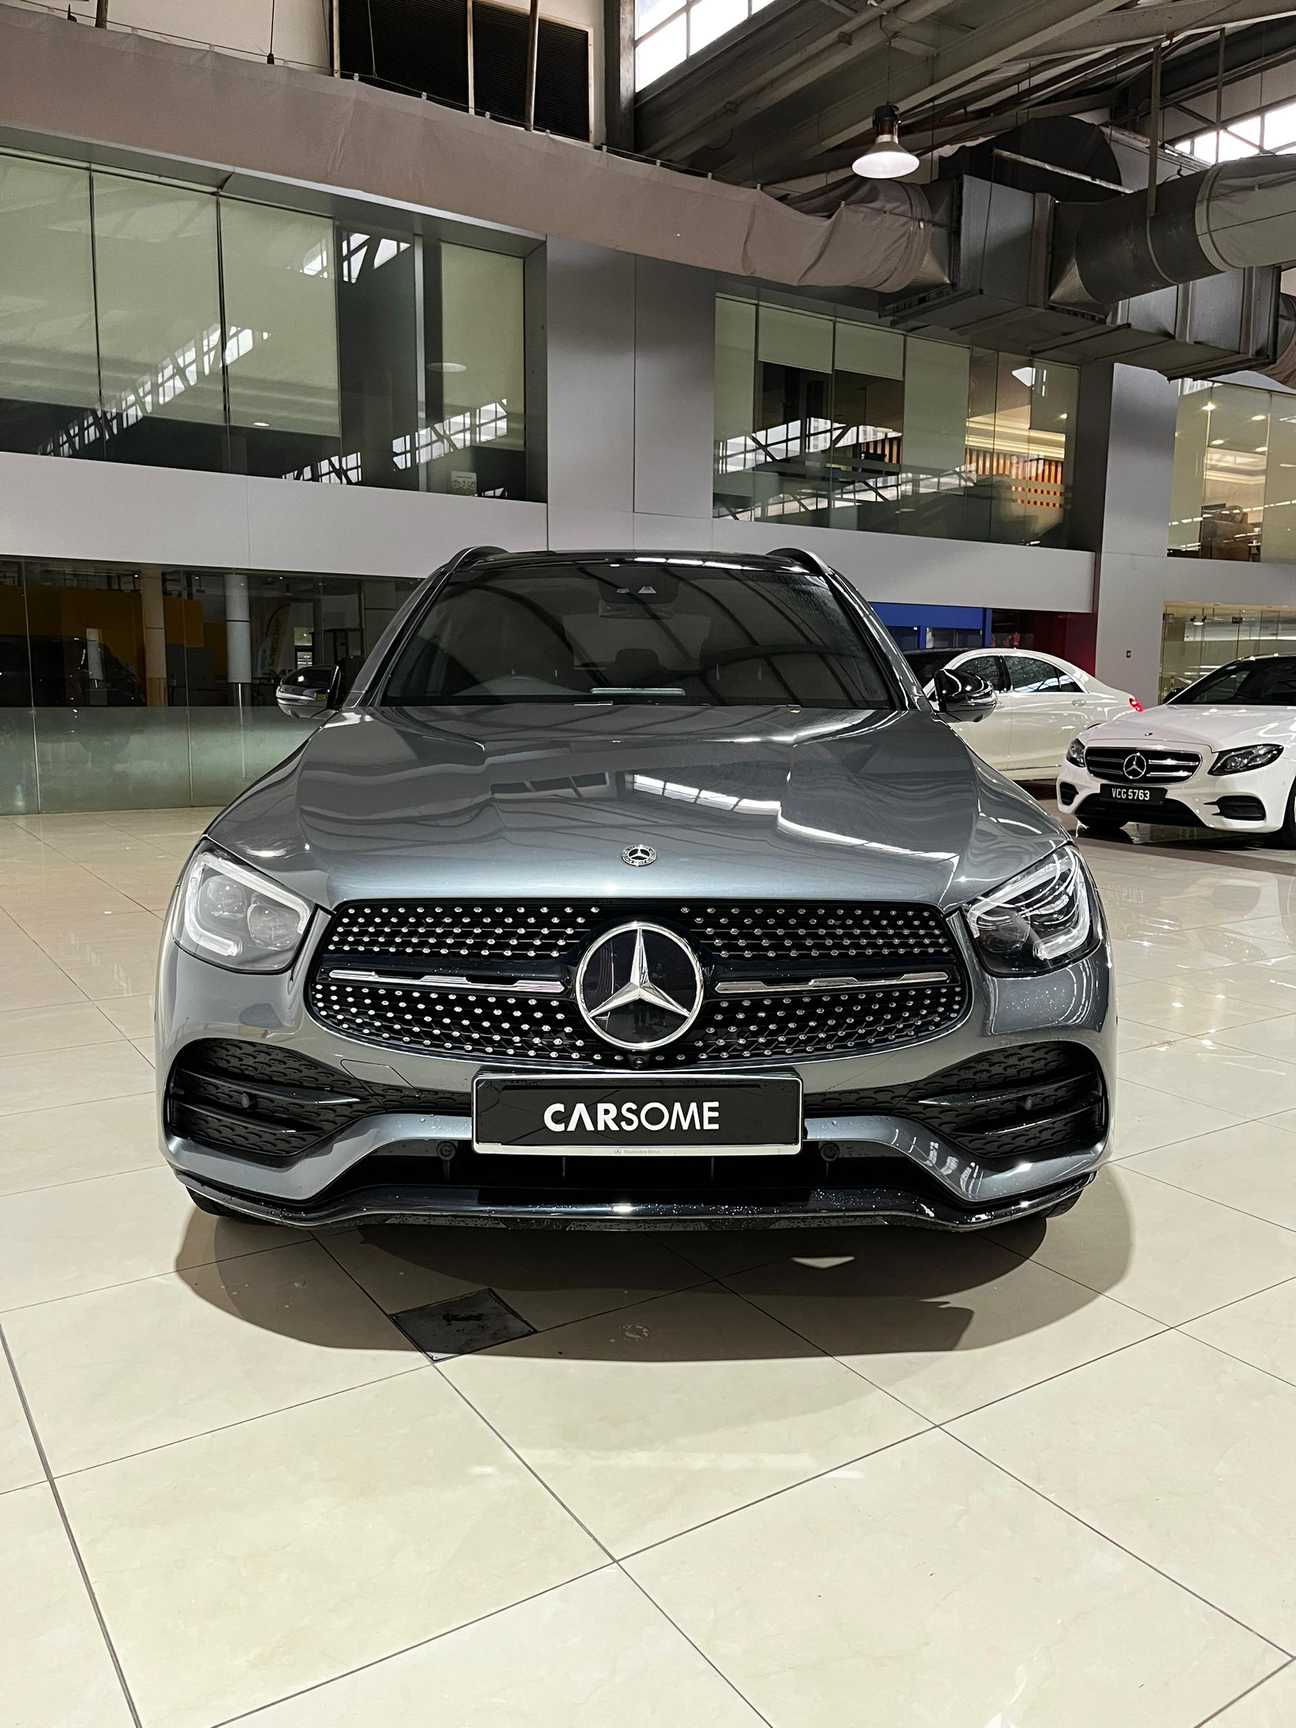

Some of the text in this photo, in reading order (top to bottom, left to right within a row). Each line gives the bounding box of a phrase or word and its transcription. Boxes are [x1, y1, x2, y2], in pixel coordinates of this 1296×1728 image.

[1111, 787, 1150, 801] VCG 5763
[543, 1101, 720, 1132] CARSOME
